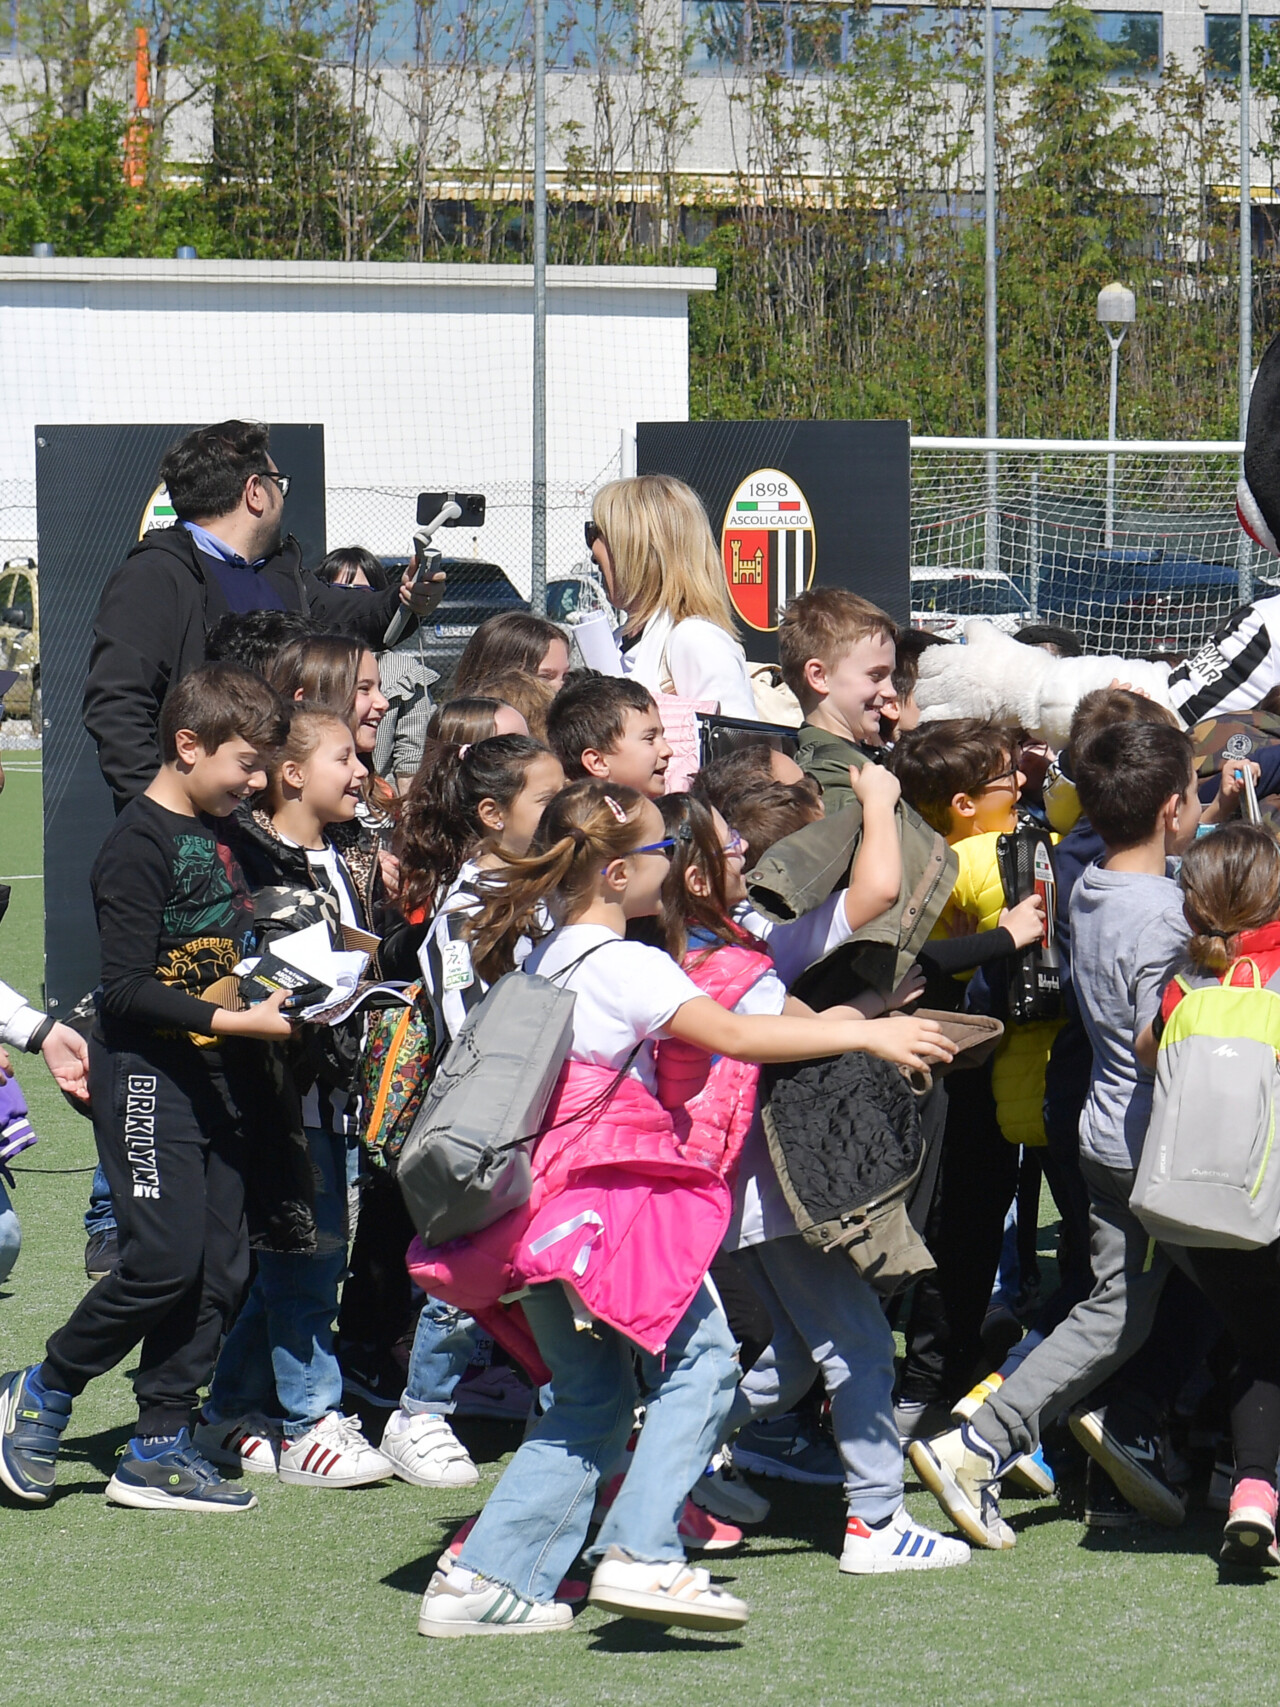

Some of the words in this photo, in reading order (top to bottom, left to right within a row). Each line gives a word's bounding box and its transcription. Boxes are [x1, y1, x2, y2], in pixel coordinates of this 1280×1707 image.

[749, 482, 788, 497] 1898
[729, 516, 768, 525] ASCOLI
[769, 515, 808, 525] CALCIO
[125, 1074, 160, 1186] BRKLYN
[133, 1184, 161, 1199] NYC
